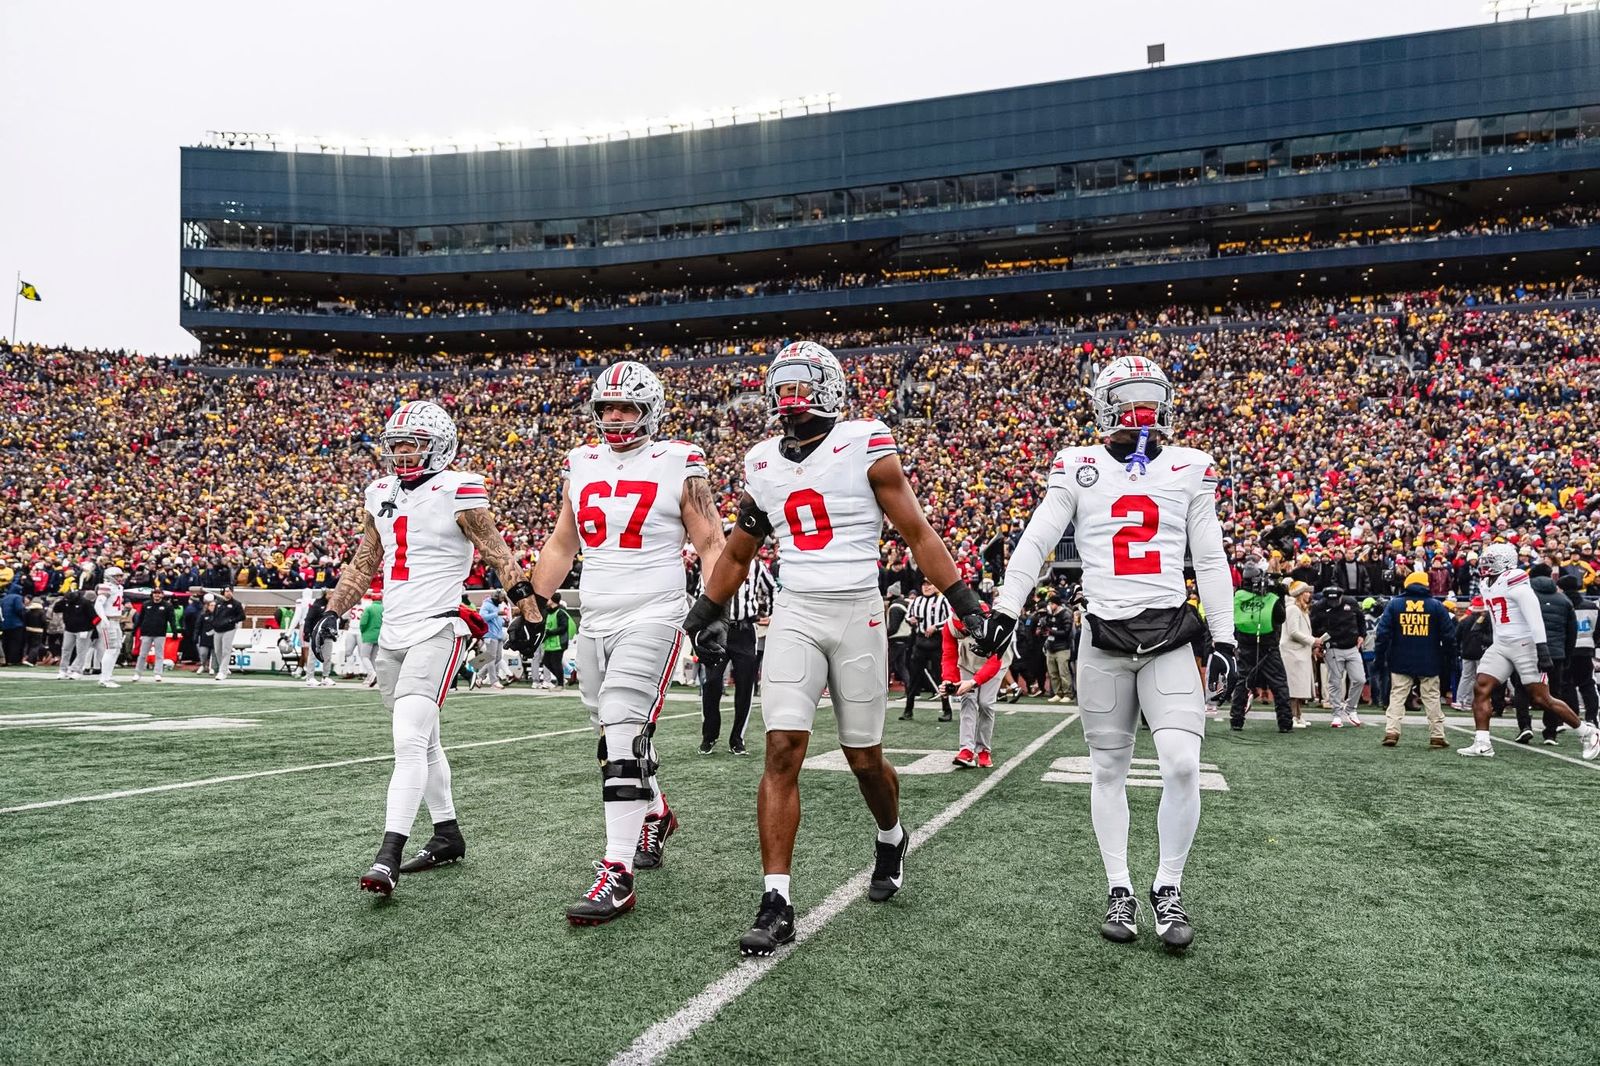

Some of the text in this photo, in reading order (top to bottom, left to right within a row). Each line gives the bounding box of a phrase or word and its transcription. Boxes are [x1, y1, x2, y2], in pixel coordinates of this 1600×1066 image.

[577, 480, 658, 549] 67
[783, 487, 834, 552] 0
[1110, 494, 1162, 576] 2
[390, 515, 410, 582] 1
[1399, 613, 1431, 625] EVENT
[1401, 624, 1429, 636] TEAM
